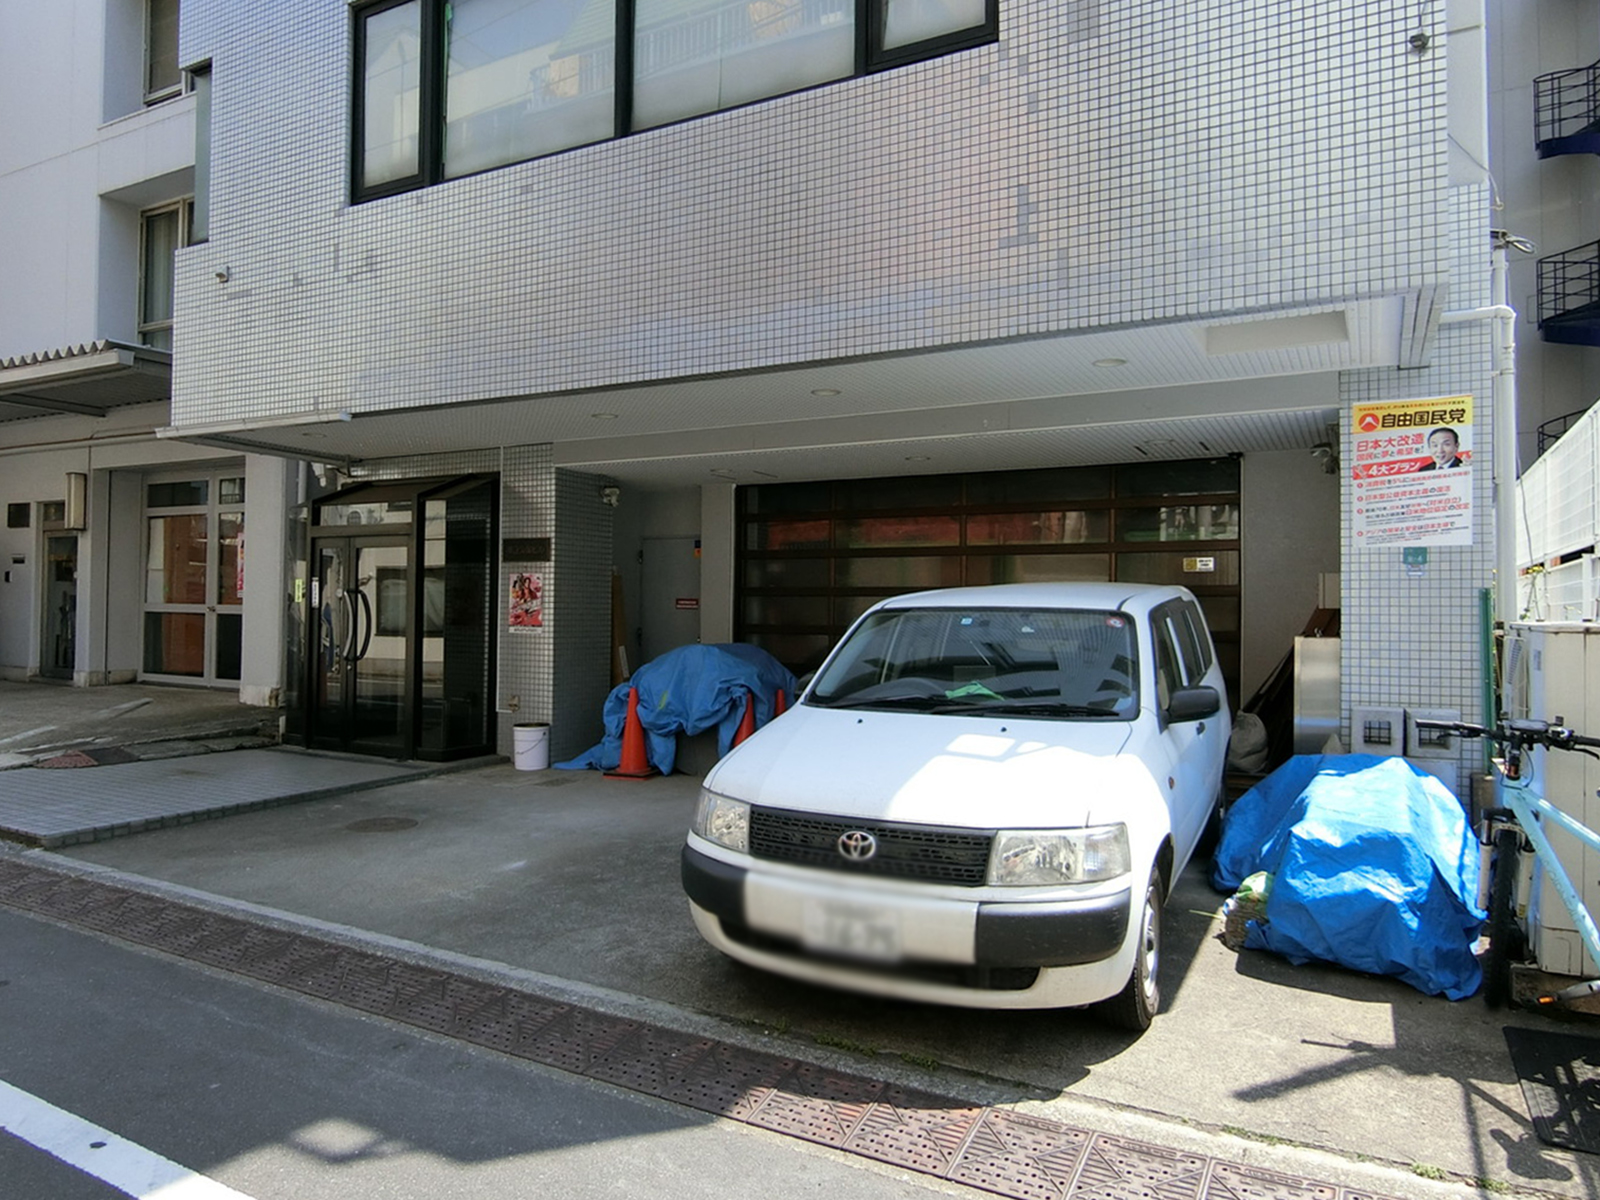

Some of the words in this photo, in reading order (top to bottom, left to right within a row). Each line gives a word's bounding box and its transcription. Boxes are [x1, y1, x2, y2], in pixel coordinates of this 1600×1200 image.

[1381, 409, 1465, 428] 自由国民党
[1357, 433, 1424, 452] 日本大改造
[1368, 461, 1421, 476] 4大プラン
